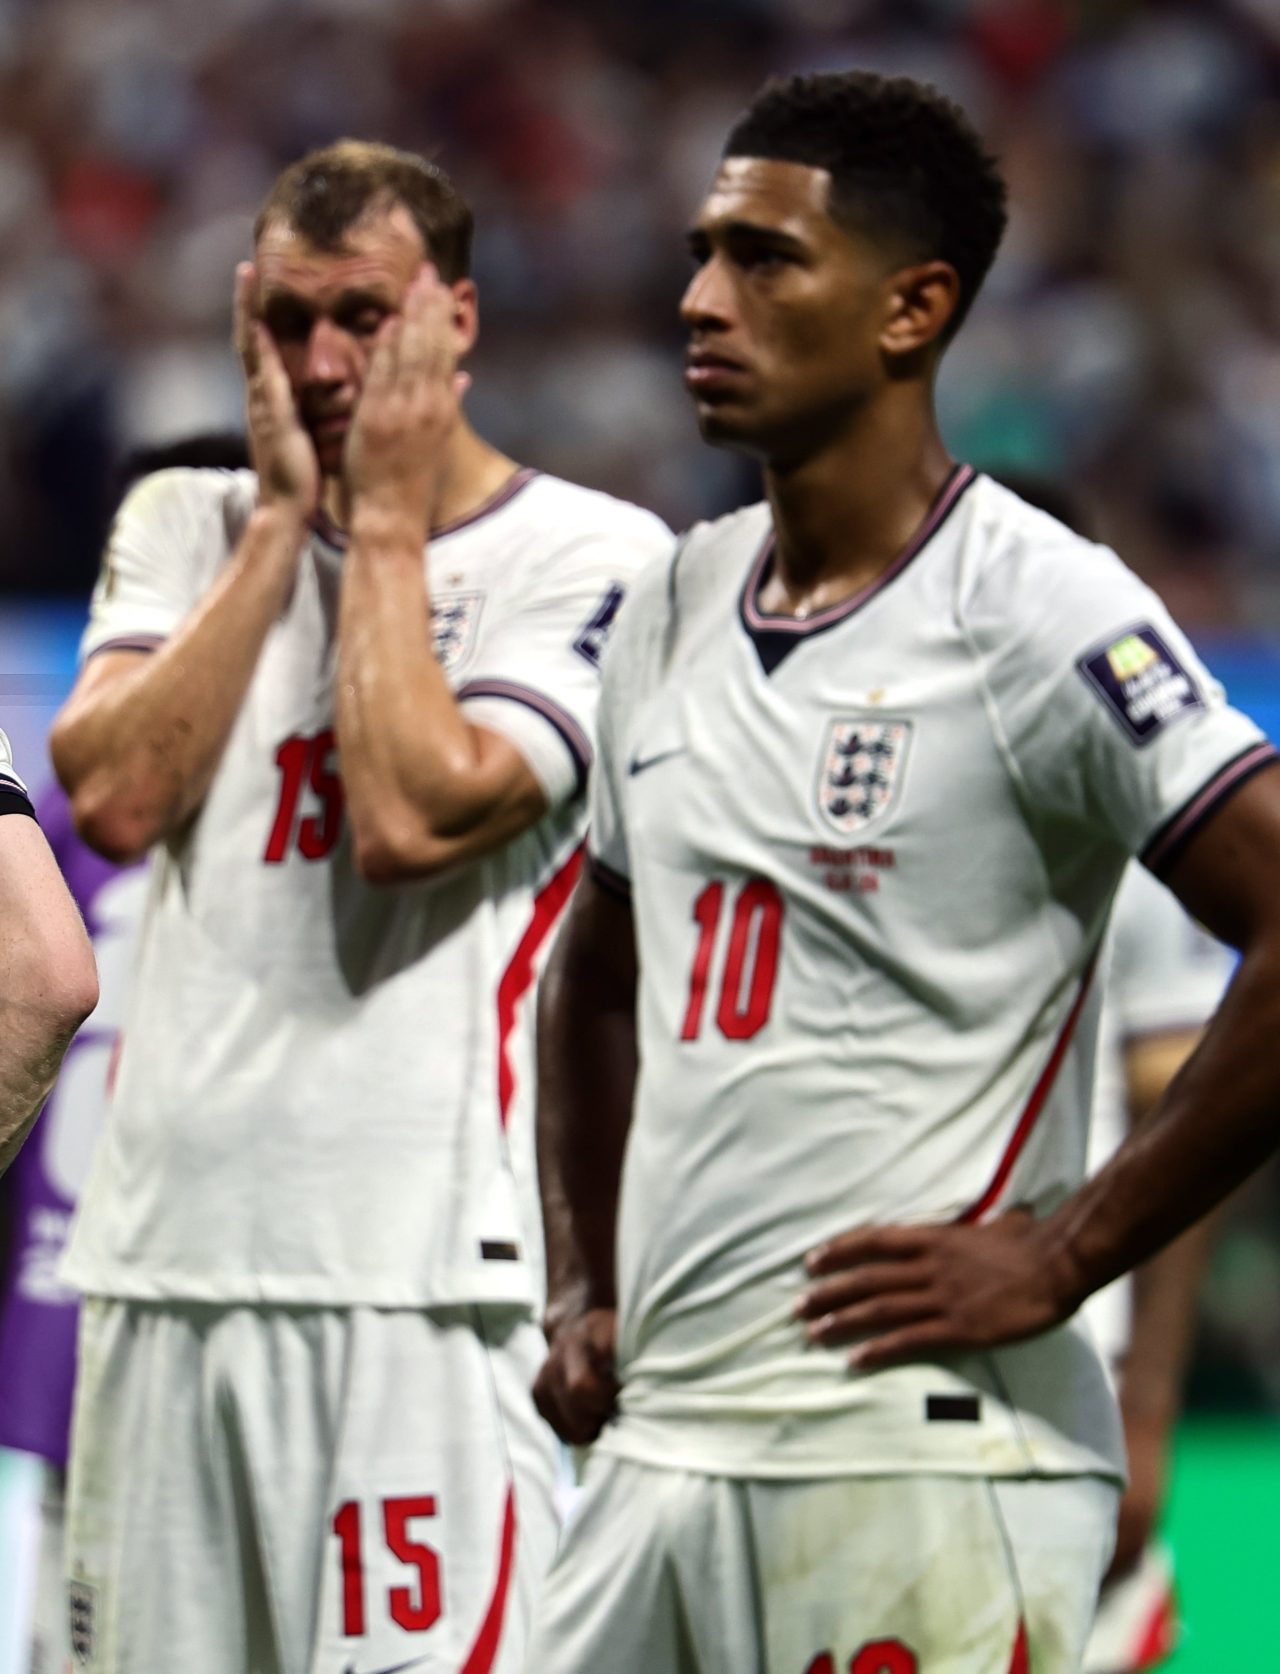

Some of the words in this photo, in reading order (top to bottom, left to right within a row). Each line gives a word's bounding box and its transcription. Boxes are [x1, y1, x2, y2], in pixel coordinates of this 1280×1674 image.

[263, 726, 347, 863] 15
[680, 877, 784, 1042] 10
[332, 1495, 443, 1637] 15
